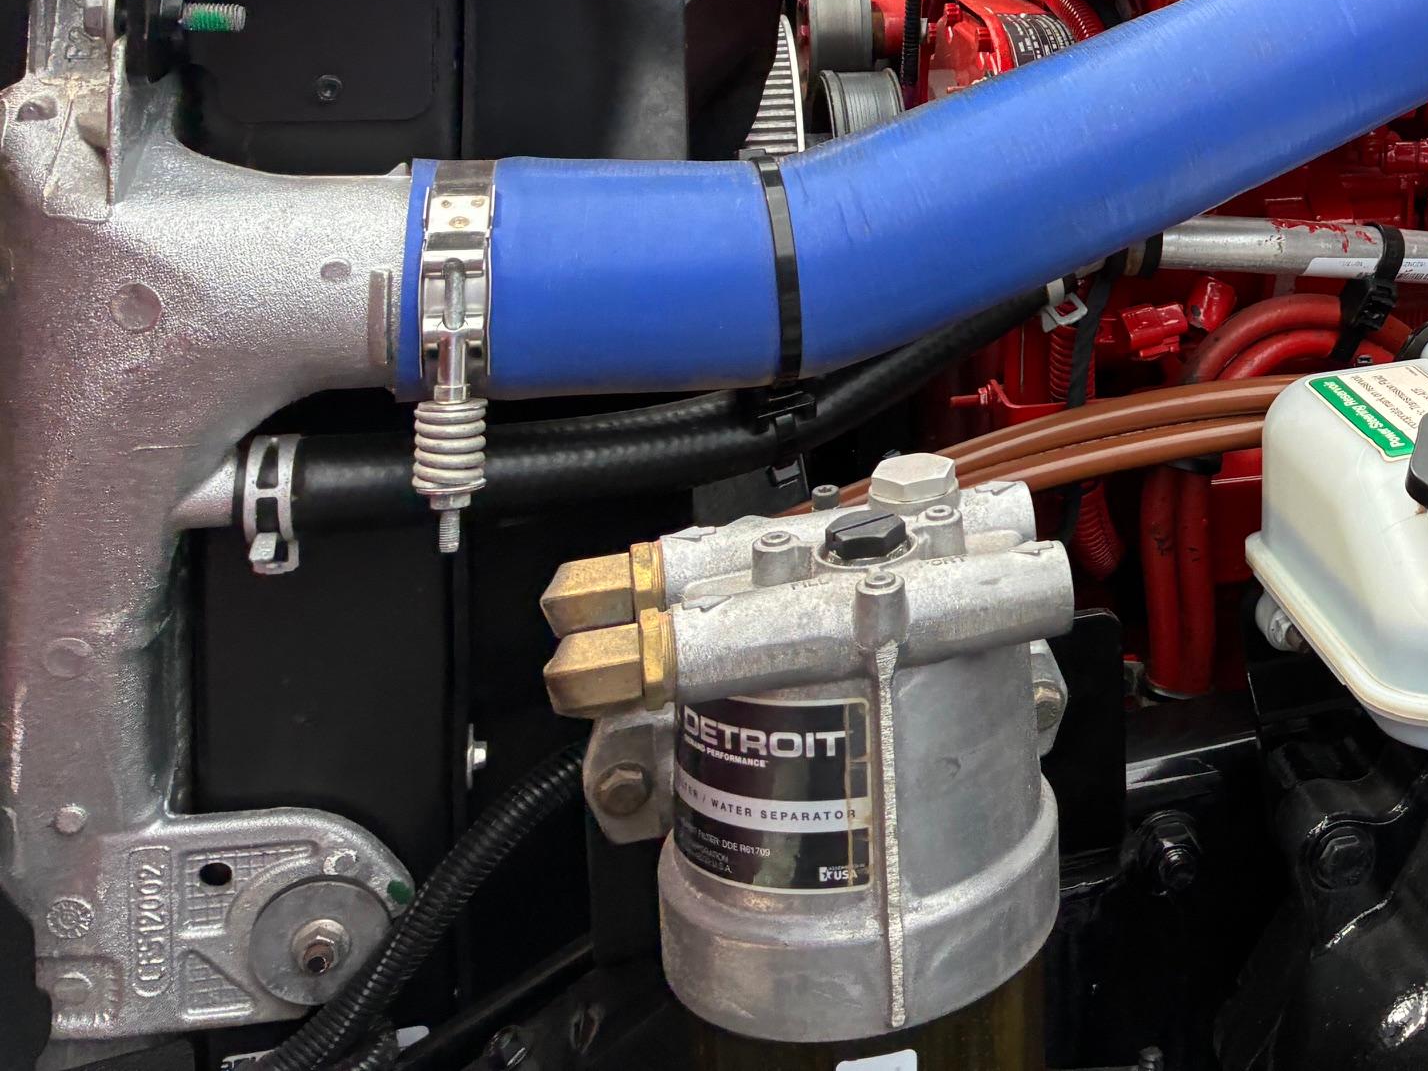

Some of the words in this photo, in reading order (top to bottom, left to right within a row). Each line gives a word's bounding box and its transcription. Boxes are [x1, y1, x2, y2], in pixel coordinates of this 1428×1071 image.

[1352, 404, 1384, 430] Steering
[1377, 427, 1406, 448] Power
[683, 705, 846, 759] DETROIT
[711, 799, 752, 817] WATER
[760, 809, 857, 822] SEPARATOR
[721, 837, 738, 852] DDE
[833, 869, 858, 880] USA
